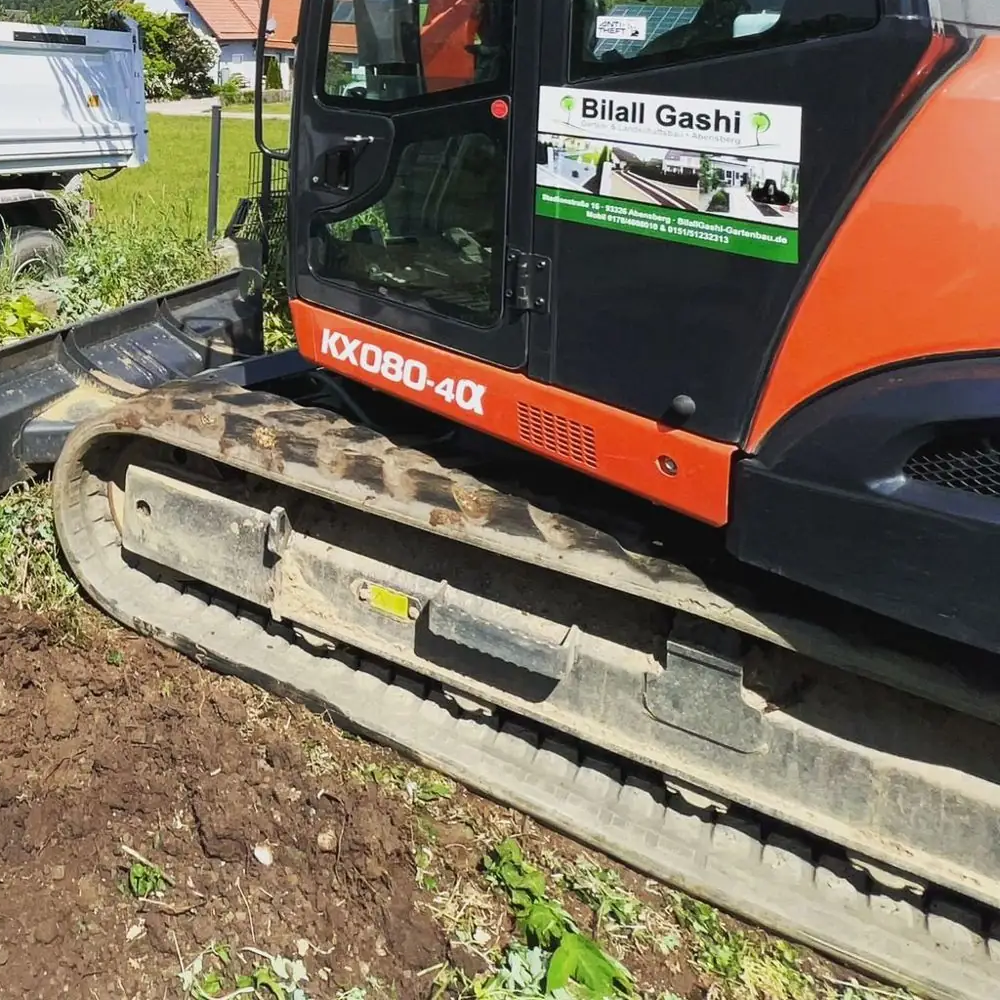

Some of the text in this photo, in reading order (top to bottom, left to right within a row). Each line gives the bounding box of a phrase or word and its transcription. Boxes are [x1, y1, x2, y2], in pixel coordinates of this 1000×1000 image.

[582, 97, 741, 134] Bilall Gashi
[692, 132, 742, 145] Abensberg
[628, 209, 671, 225] Abensberg
